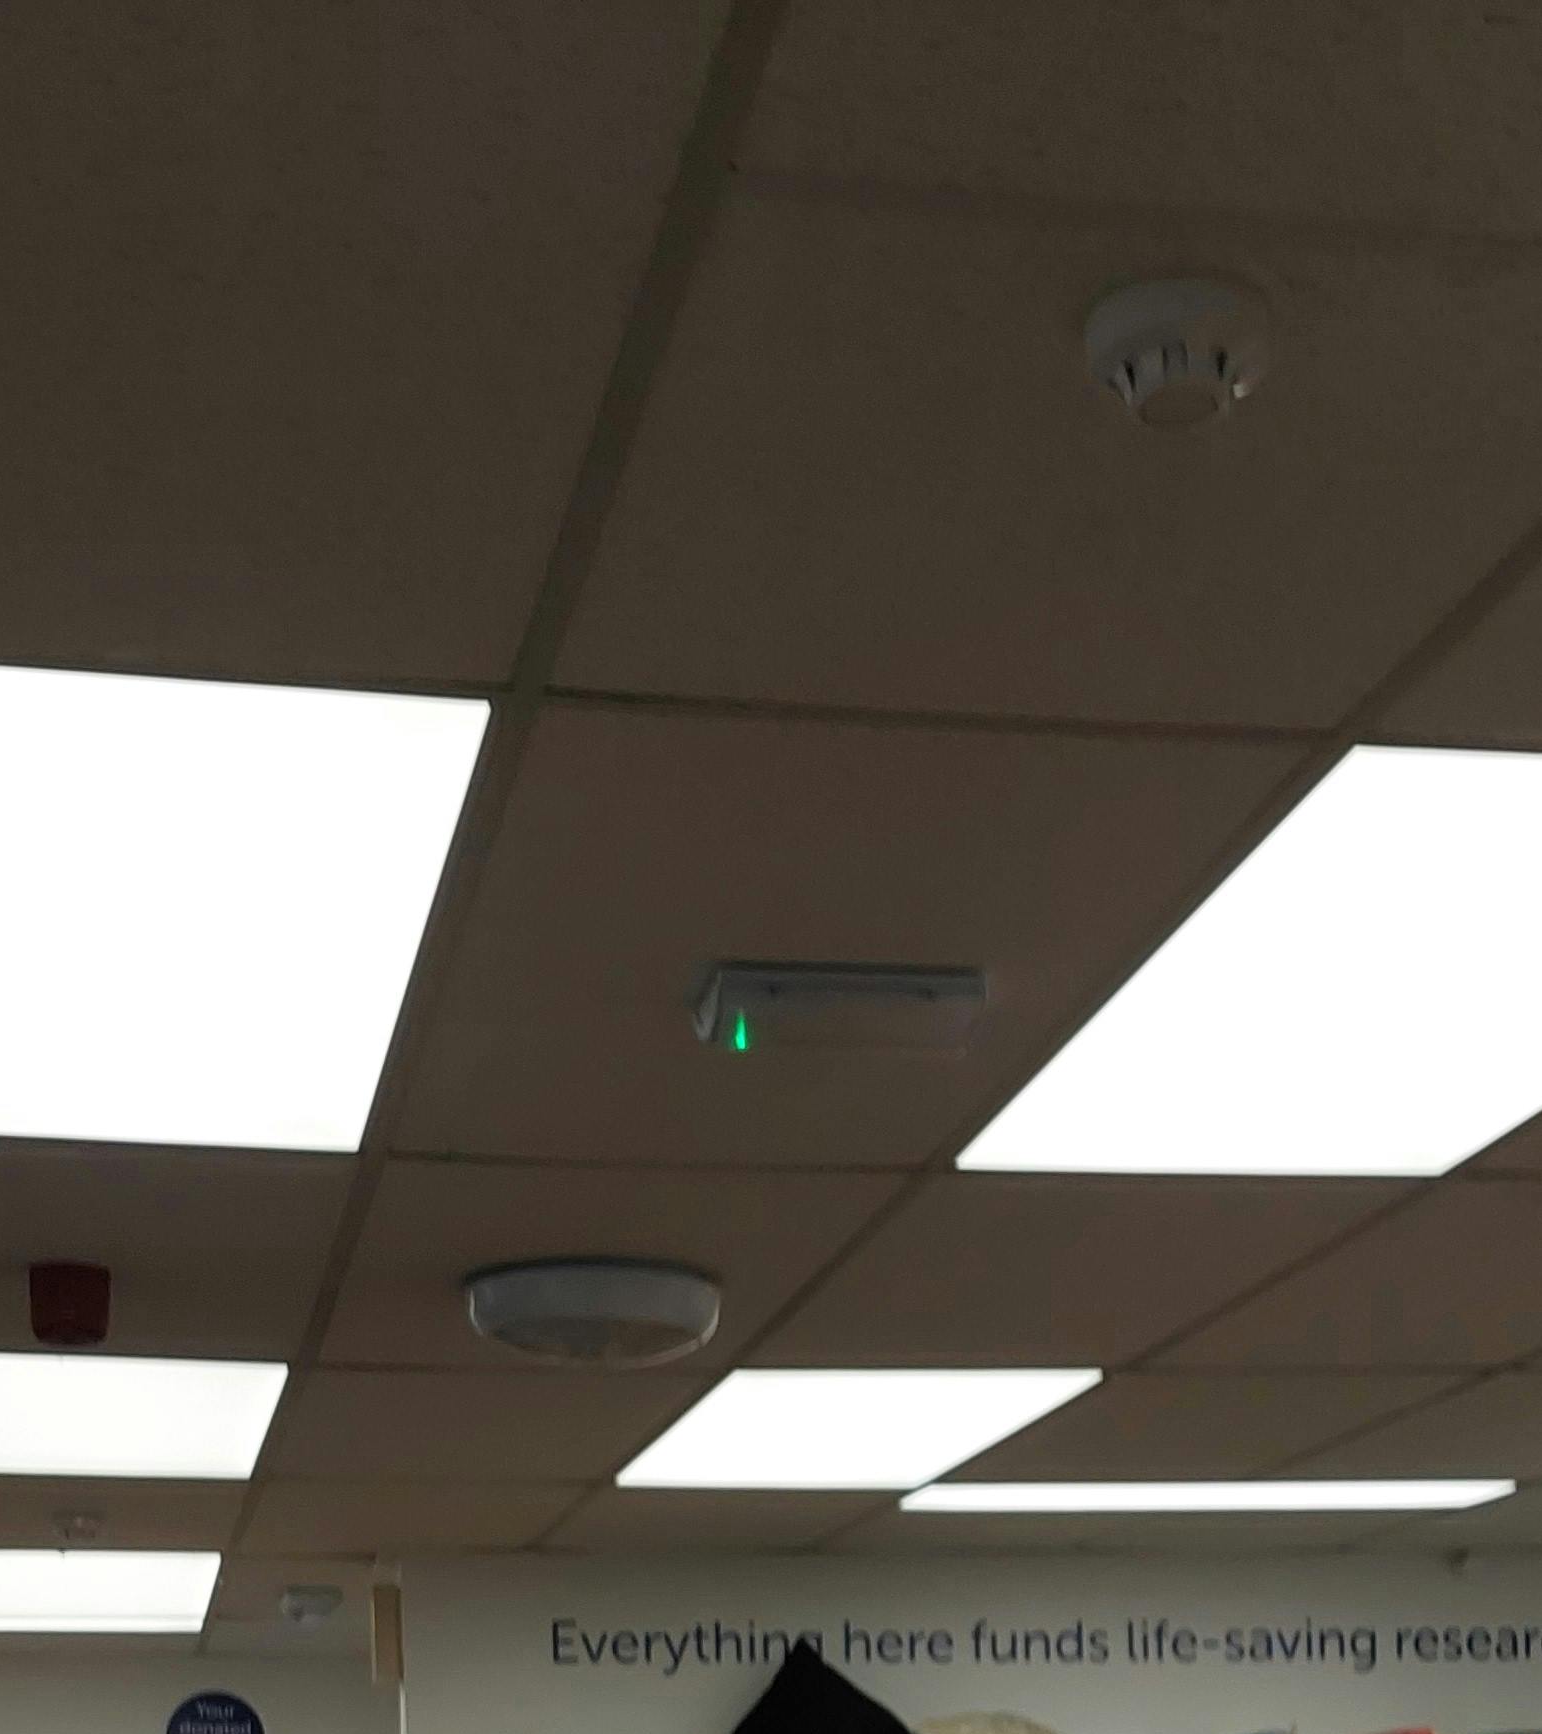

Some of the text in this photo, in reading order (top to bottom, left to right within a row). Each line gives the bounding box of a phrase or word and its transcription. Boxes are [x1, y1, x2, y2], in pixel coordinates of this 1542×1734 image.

[843, 1617, 954, 1664] here
[972, 1617, 1109, 1664] funds
[1128, 1615, 1377, 1675] life-saving
